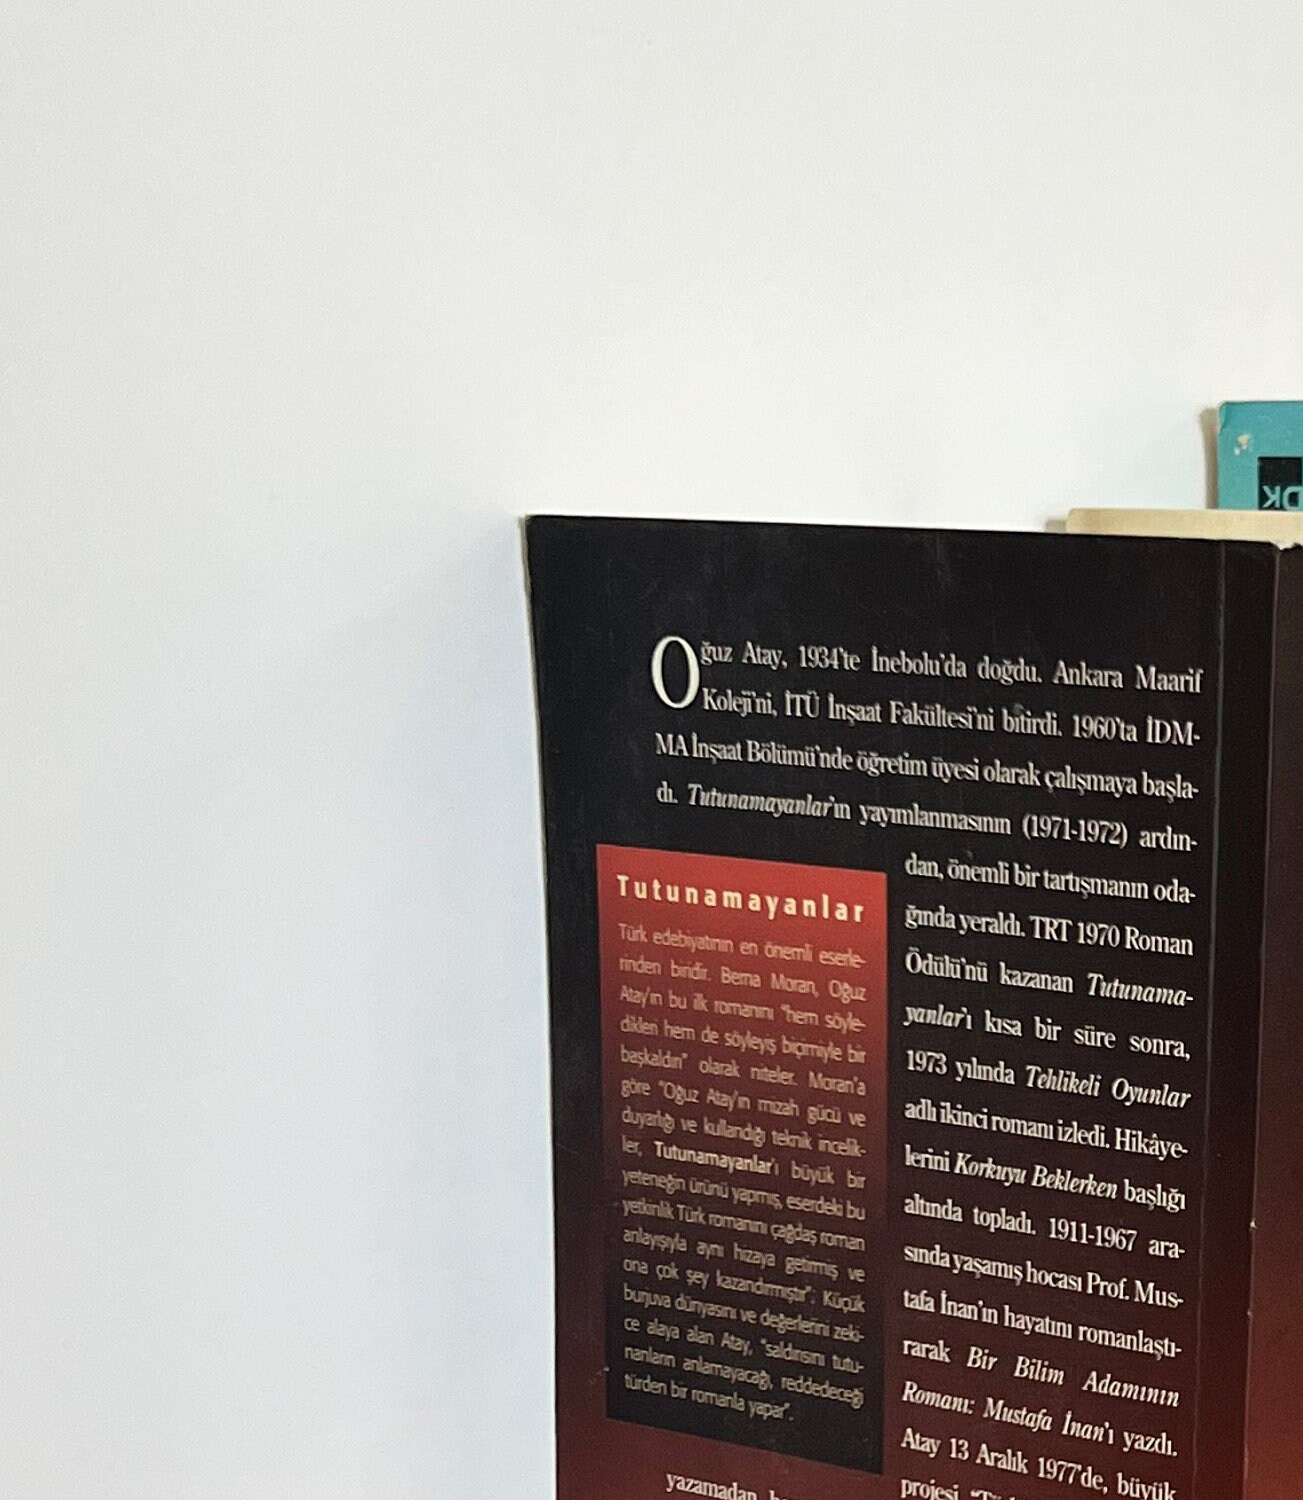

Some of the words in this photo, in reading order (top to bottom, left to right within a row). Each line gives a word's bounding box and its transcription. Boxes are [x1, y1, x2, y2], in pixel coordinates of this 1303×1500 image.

[741, 640, 787, 670] Atay,
[977, 655, 1042, 685] doğdu.
[1052, 659, 1123, 688] Ankara
[1135, 664, 1204, 693] Maarif
[784, 689, 819, 717] İTÜ
[827, 692, 882, 724] İnşaat
[1001, 704, 1062, 736] bitirdi.
[654, 732, 689, 757] MA
[691, 731, 743, 762] İnşaat
[856, 750, 928, 776] öğretim
[930, 756, 979, 783] üyesi
[982, 758, 1040, 786] olarak
[1044, 764, 1137, 798] çalışmaya
[656, 780, 678, 803] dı.
[858, 802, 1011, 834] yayımlanmasının
[1022, 814, 1128, 848] (1971-1972)
[616, 874, 863, 922] Tutunamayanlar
[906, 1049, 947, 1074] 1973
[954, 1056, 1015, 1085] yılında
[1025, 1064, 1102, 1096] Tehlikeli
[1111, 1077, 1191, 1107] Oyunlar
[904, 1143, 950, 1172] lerini
[953, 1152, 1026, 1186] Korkuyu
[1030, 1164, 1117, 1199] Beklerken
[1122, 1178, 1185, 1213] başlığı
[901, 1380, 975, 1414] Romanı:
[982, 1396, 1052, 1432] Mustafa
[1122, 1431, 1177, 1456] yazdı.
